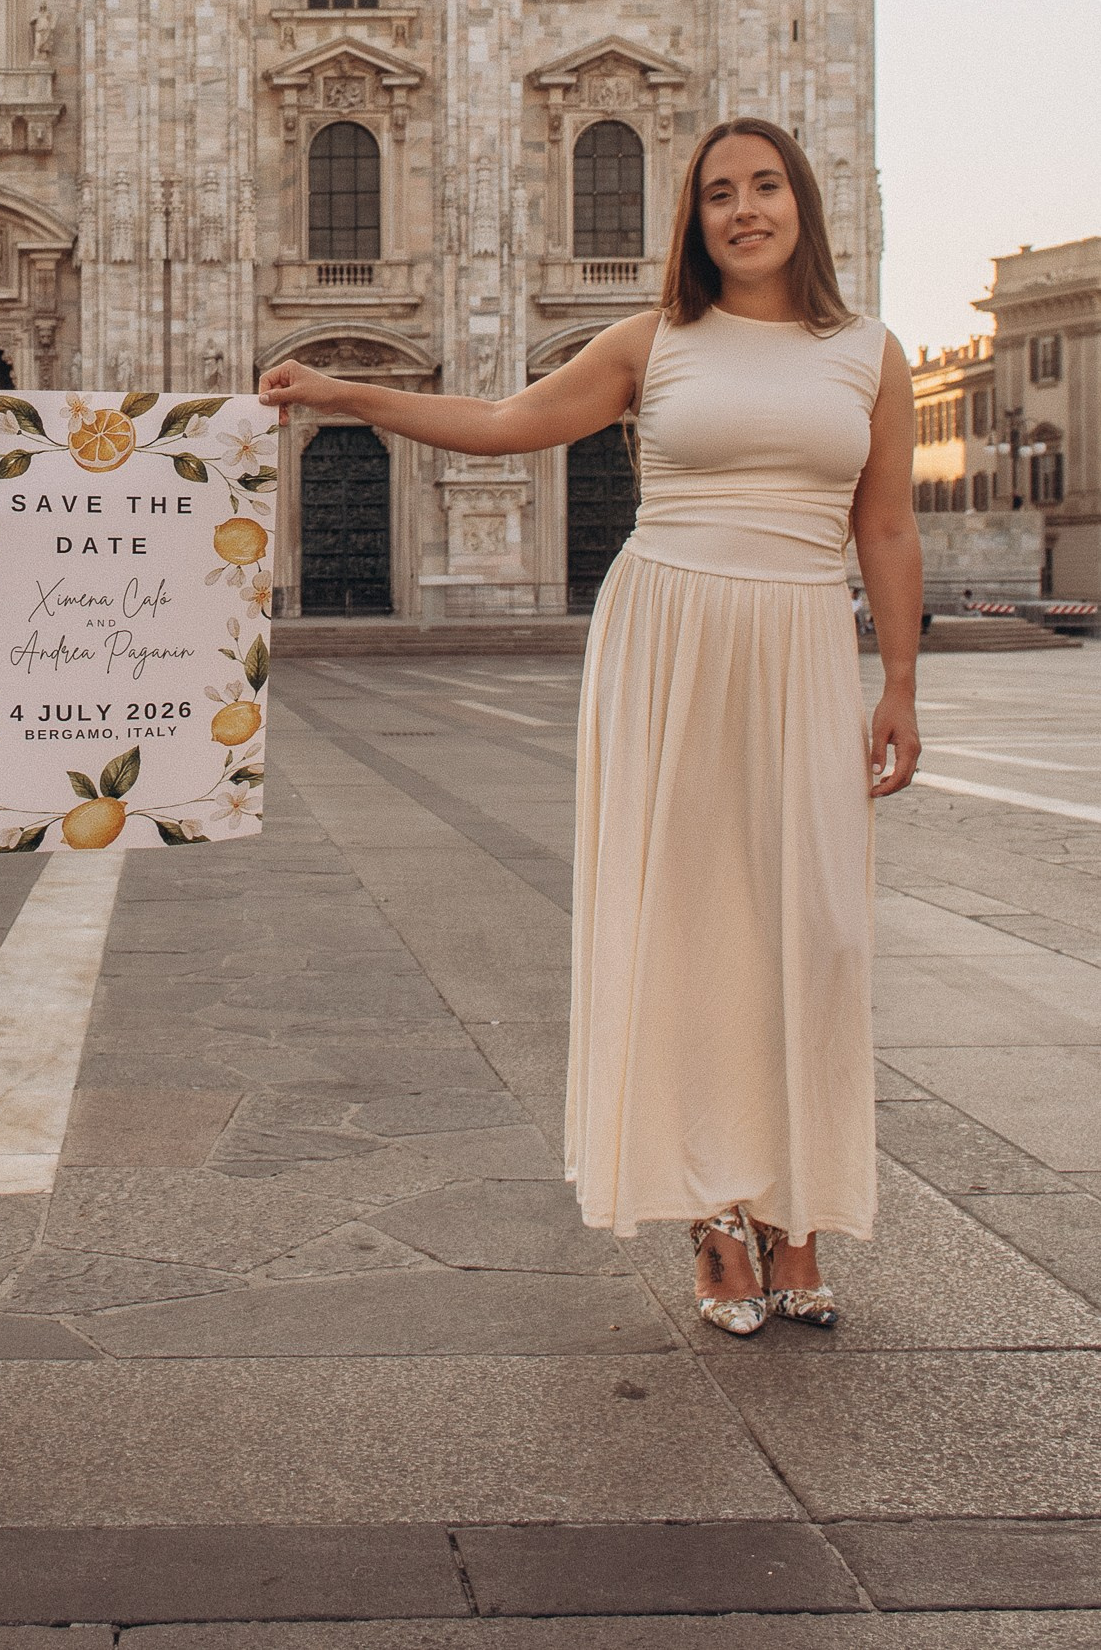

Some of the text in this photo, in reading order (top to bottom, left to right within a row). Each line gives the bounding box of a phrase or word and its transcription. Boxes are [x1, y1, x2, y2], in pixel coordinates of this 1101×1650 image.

[11, 494, 192, 515] SAVE THE
[56, 536, 147, 555] DATE
[28, 577, 172, 623] Ximena Caló
[86, 619, 117, 628] AND
[10, 629, 196, 681] Andrea Paganin
[9, 701, 192, 722] 4 JULY 2026
[24, 725, 178, 741] BERGAMO, ITALY
